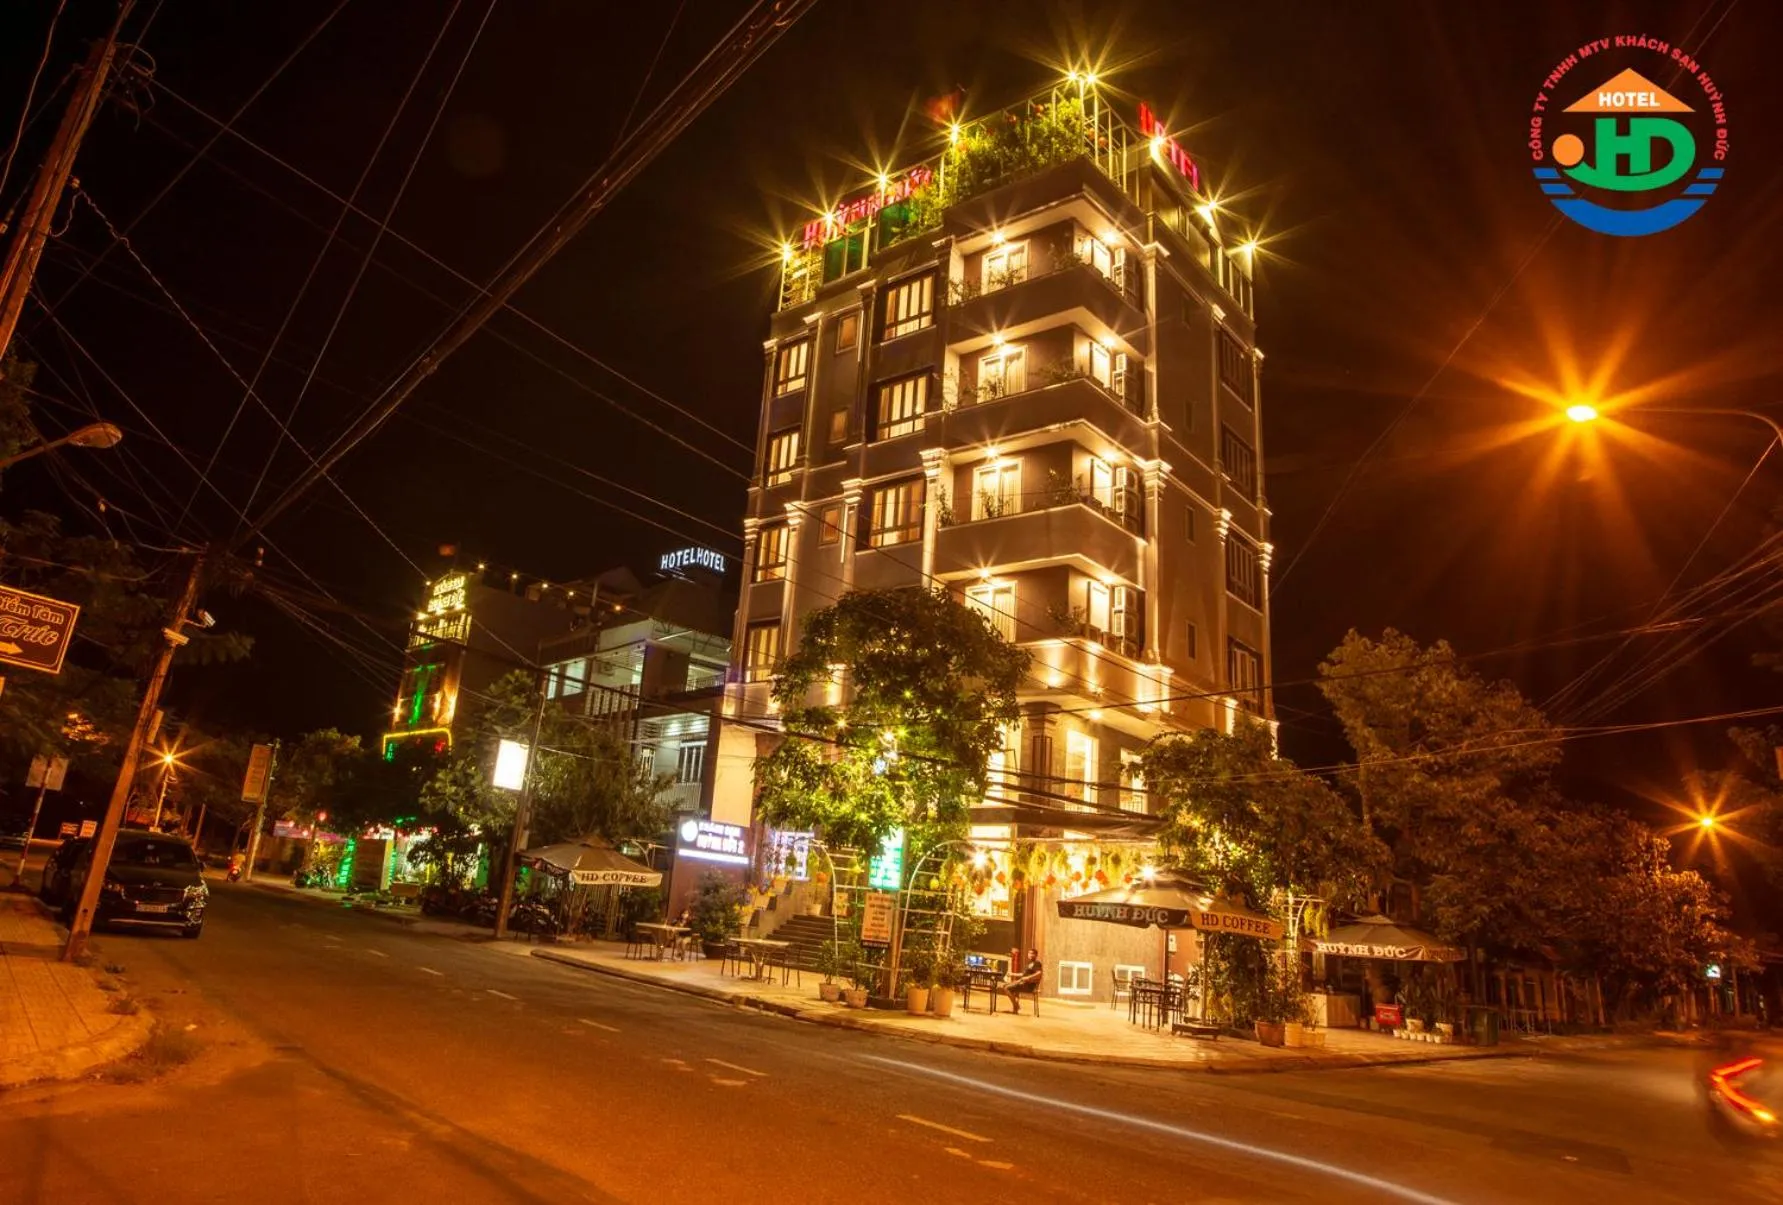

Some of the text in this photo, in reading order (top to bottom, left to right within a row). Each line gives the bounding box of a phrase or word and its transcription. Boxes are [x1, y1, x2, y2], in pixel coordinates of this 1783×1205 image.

[661, 547, 725, 573] HOTEL HOTEL
[0, 595, 31, 617] iểm
[581, 872, 599, 882] HD
[1201, 912, 1271, 935] HD COFFEE
[1316, 942, 1407, 958] HUỲNH ĐỨC
